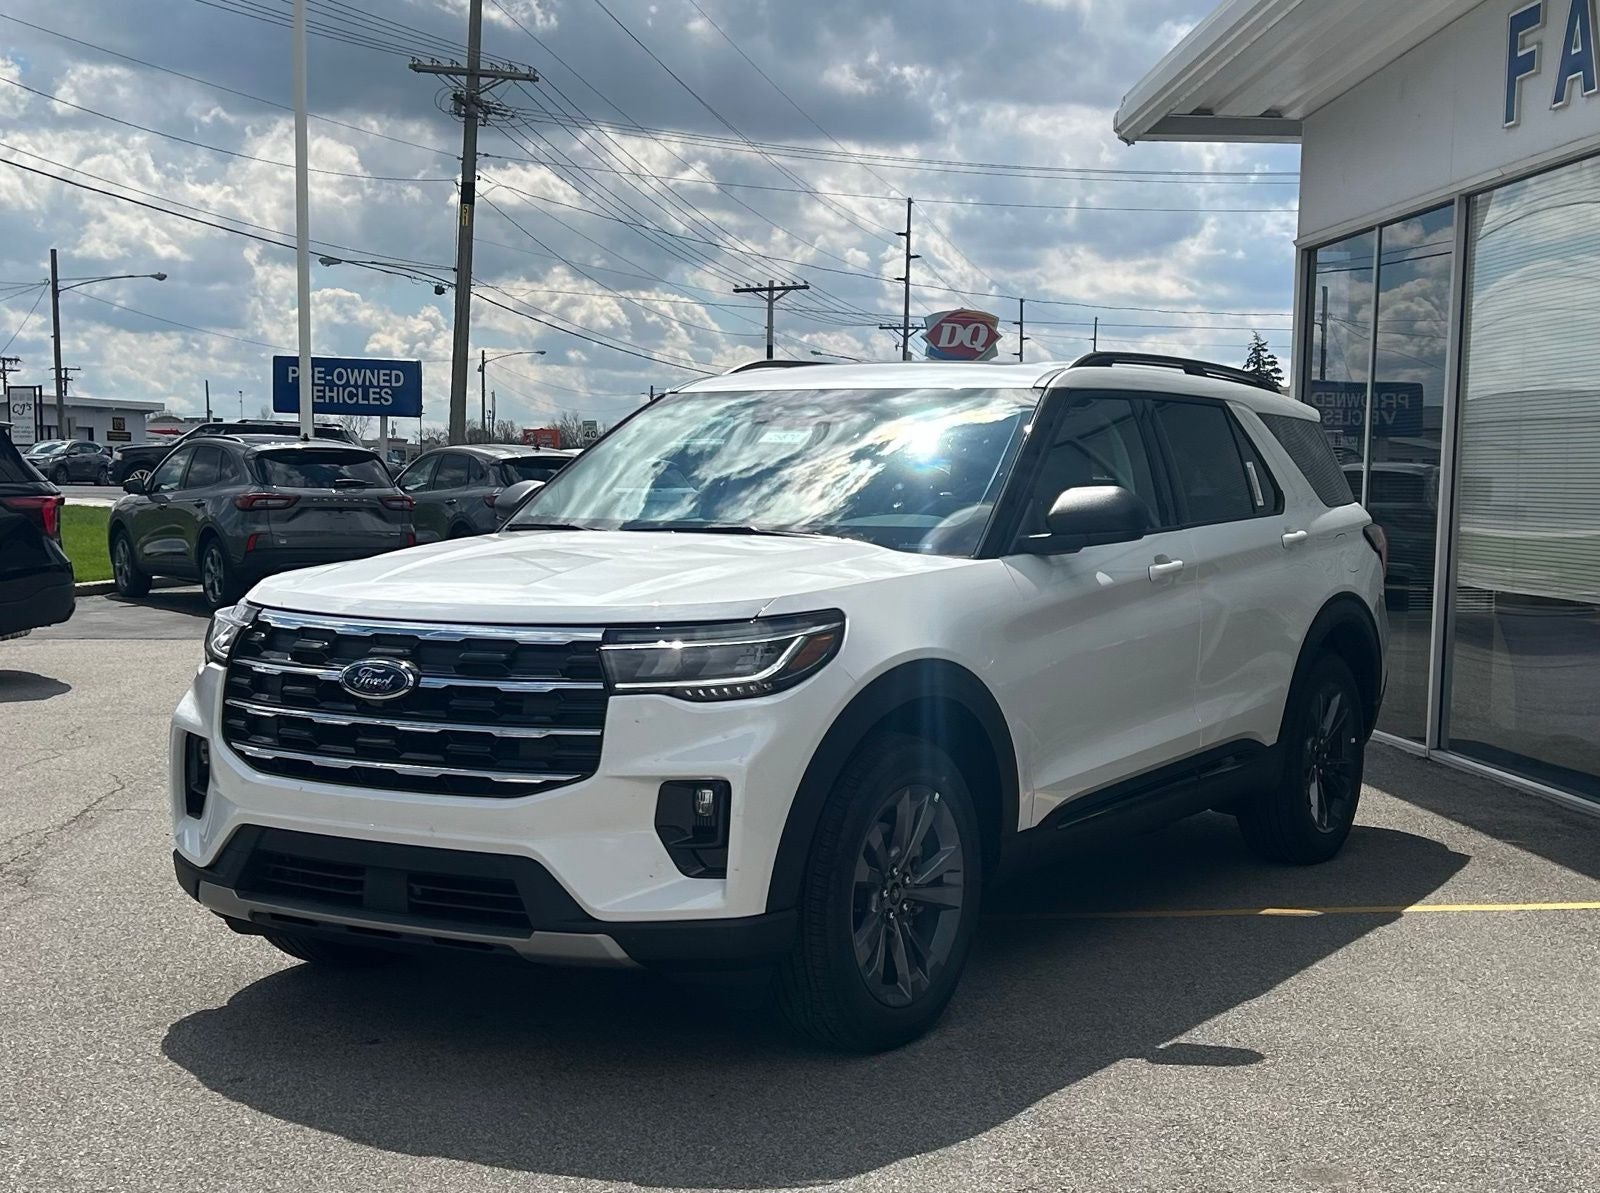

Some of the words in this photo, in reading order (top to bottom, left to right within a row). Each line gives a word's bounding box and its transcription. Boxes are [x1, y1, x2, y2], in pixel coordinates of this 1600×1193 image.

[1503, 0, 1598, 128] FA
[938, 322, 989, 352] DQ
[288, 366, 405, 387] PE-OWNED
[312, 387, 393, 406] EHICLES
[584, 430, 597, 439] 40
[353, 666, 395, 690] Ford
